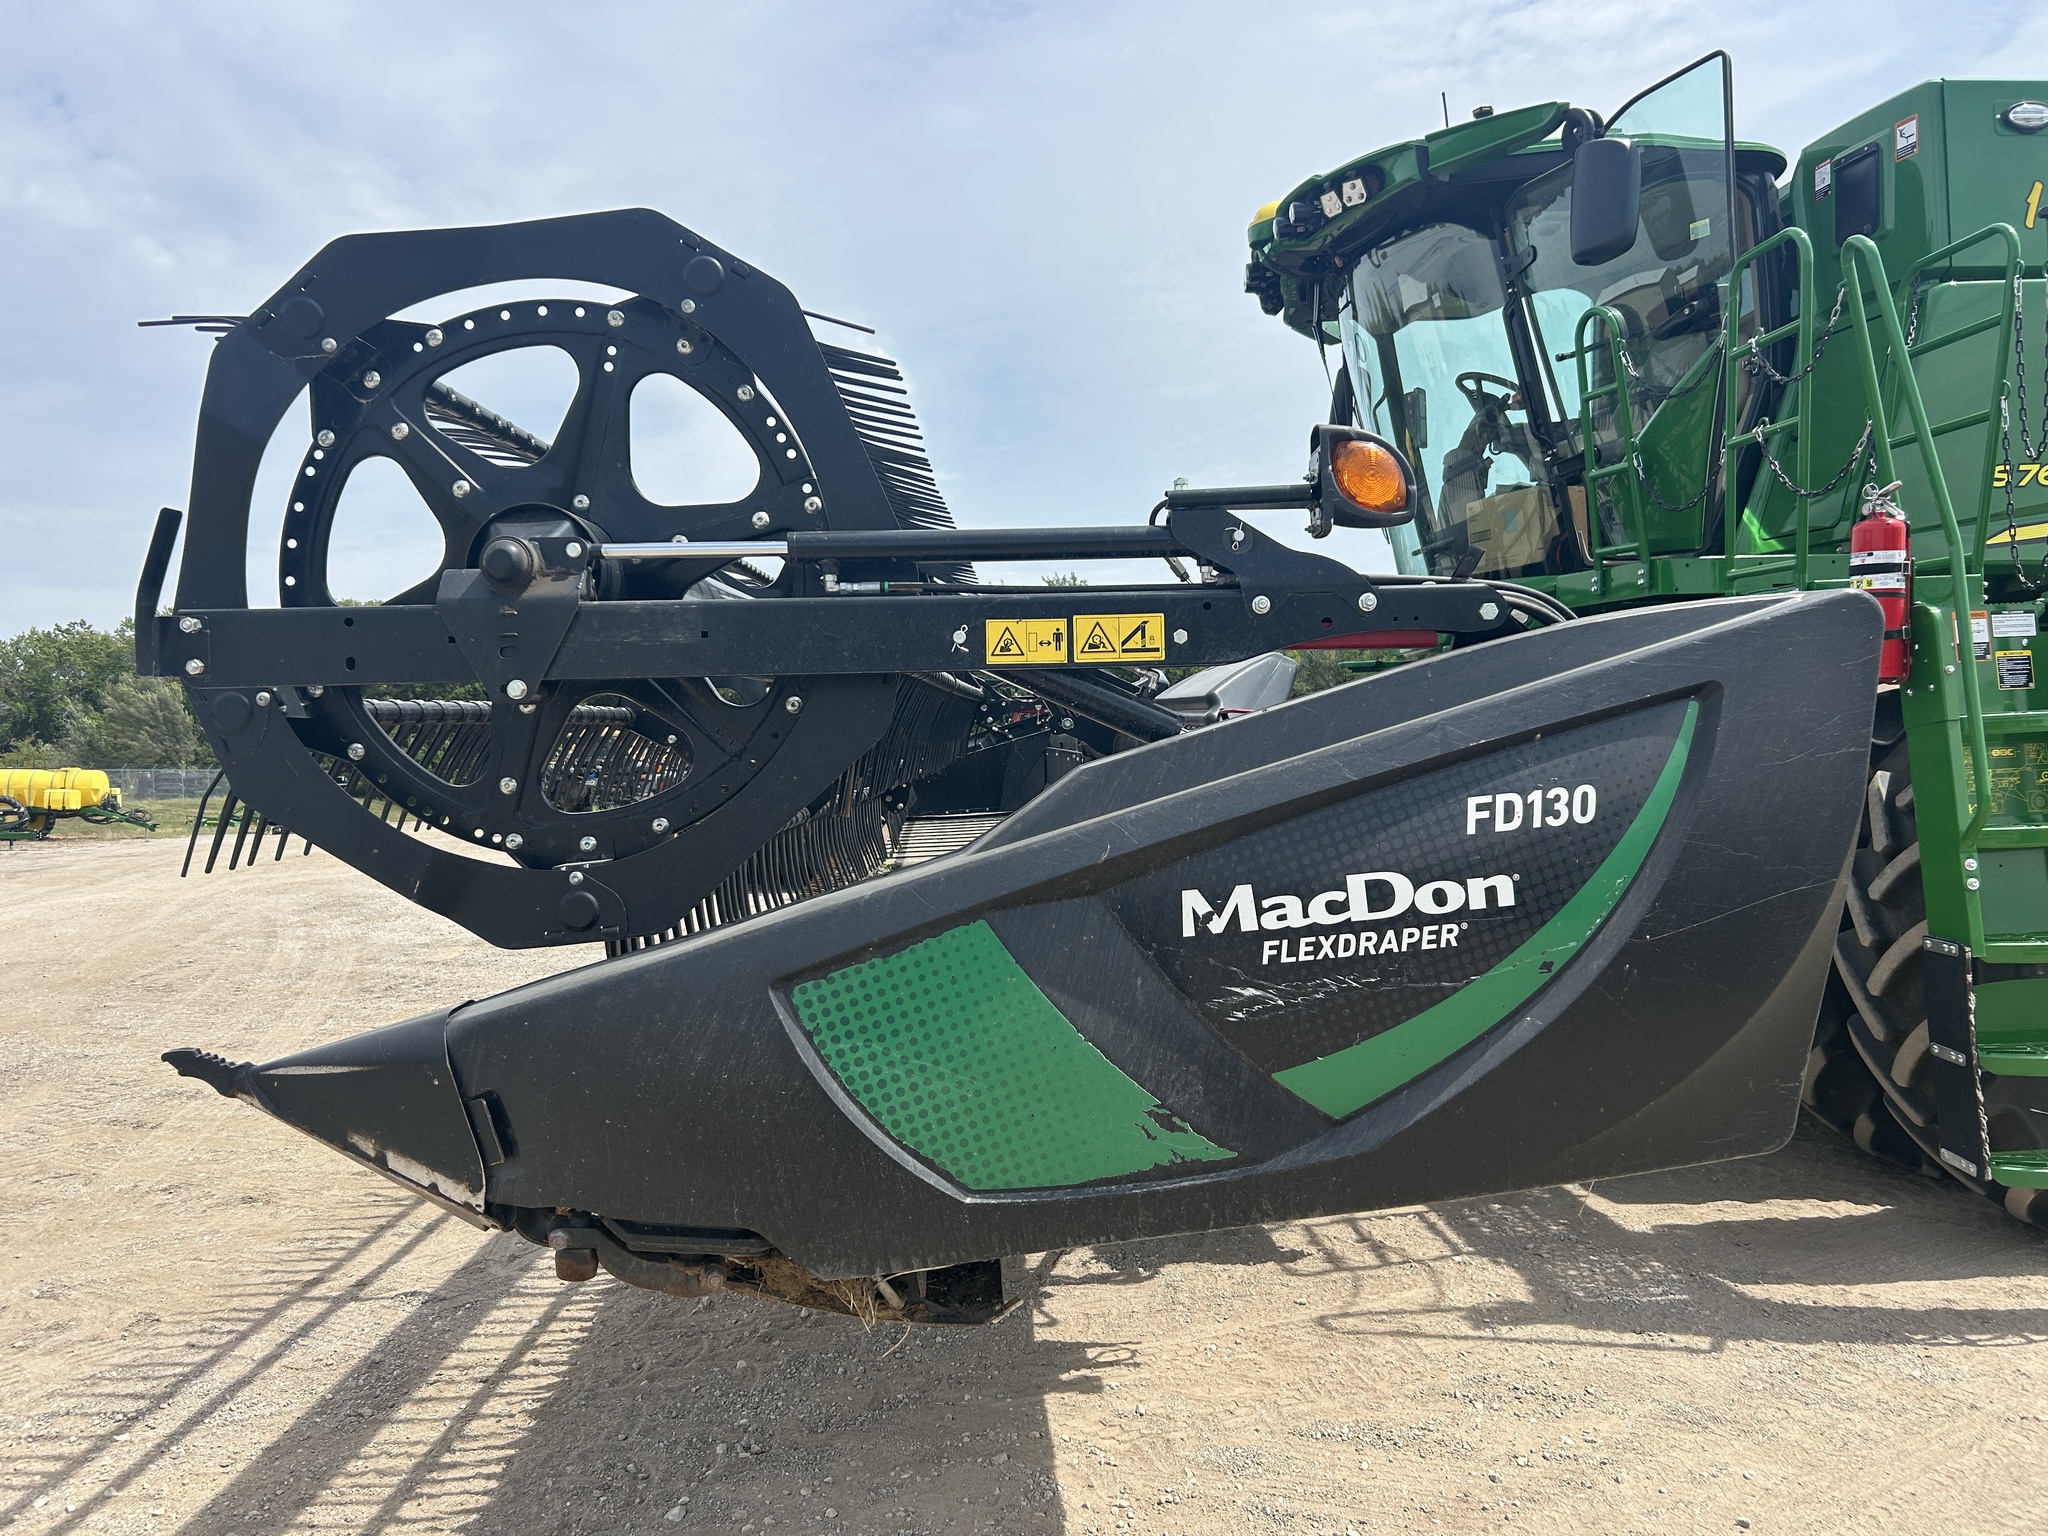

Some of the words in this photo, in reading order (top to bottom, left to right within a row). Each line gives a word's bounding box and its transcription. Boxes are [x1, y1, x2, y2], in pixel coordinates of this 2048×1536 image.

[1466, 783, 1597, 836] FD130
[1181, 870, 1515, 937] MacDon
[1261, 923, 1460, 966] FLEXDRAPER
